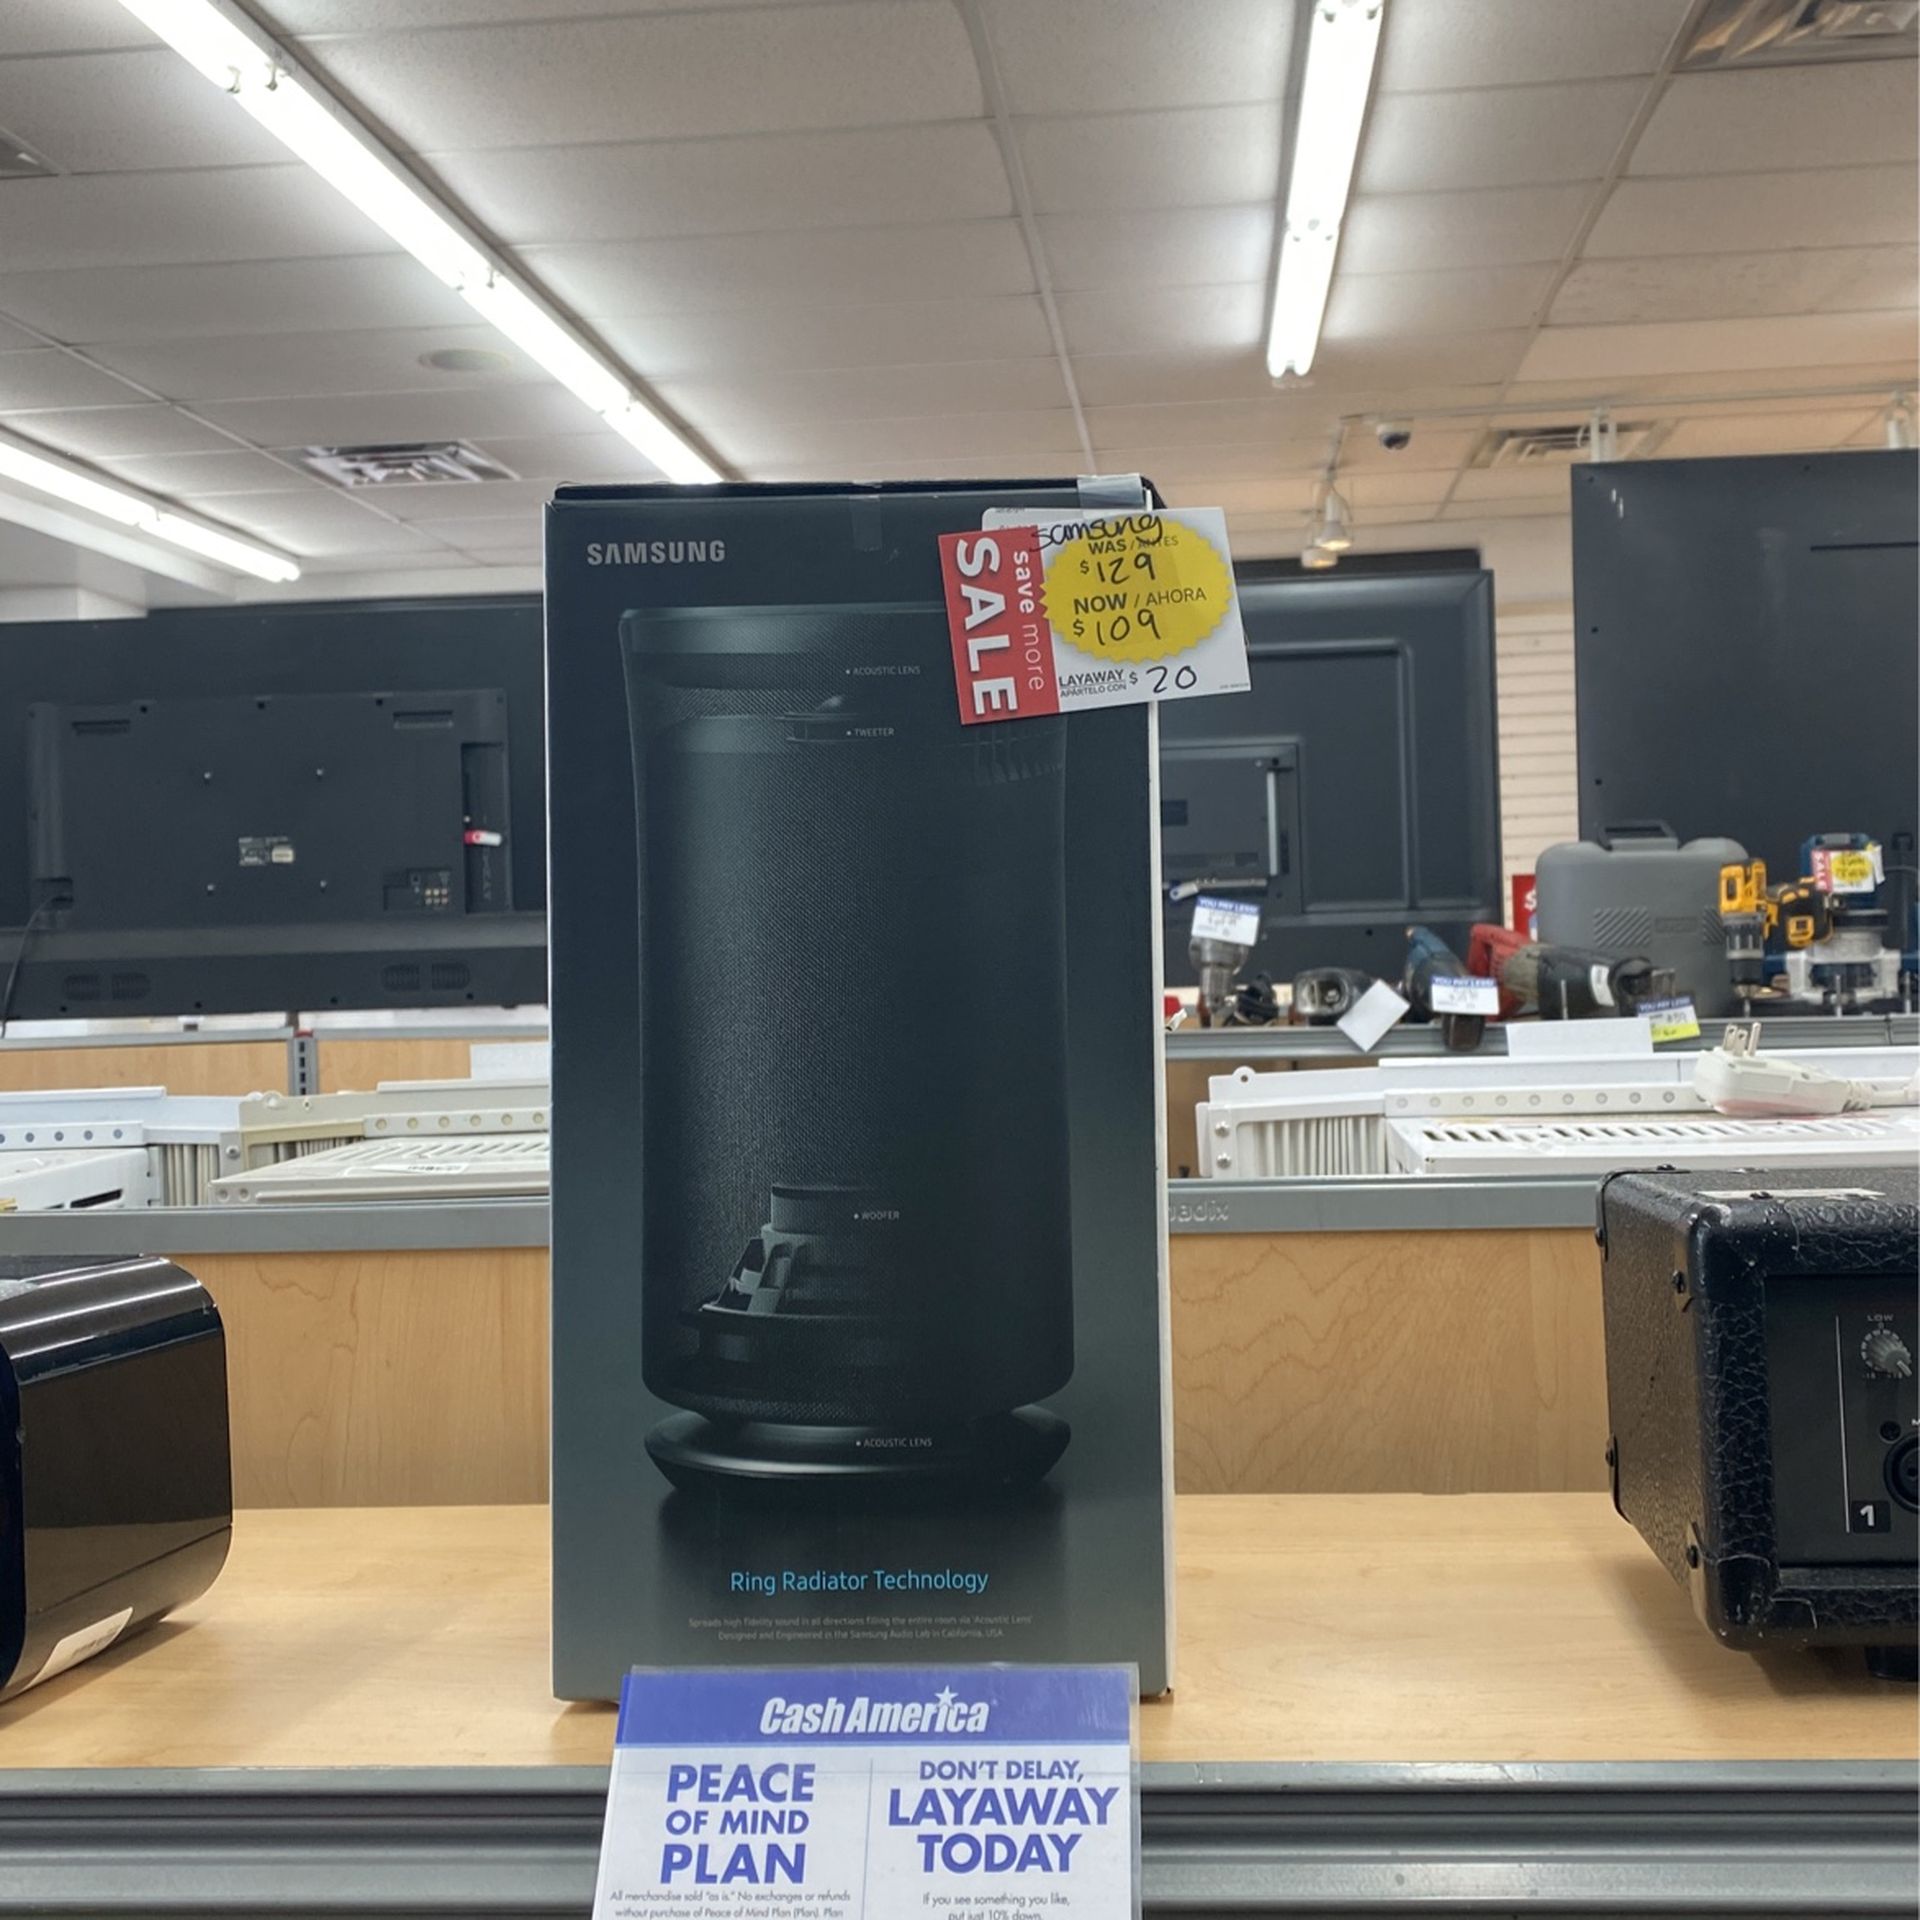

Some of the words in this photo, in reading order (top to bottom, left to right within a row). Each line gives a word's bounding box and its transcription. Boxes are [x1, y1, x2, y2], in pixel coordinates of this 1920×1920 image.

[587, 540, 726, 565] SAMSUNG
[1088, 539, 1127, 555] WAS
[1013, 550, 1036, 614] save
[1073, 592, 1128, 615] NOW
[1145, 587, 1208, 606] AHORA
[956, 537, 1019, 716] SALE
[1022, 623, 1045, 691] more
[853, 666, 896, 676] ACOUSTIC
[898, 665, 921, 675] LENS
[1058, 669, 1125, 688] LAYAWAY
[1107, 683, 1127, 692] CON
[854, 727, 895, 737] TWEETER
[861, 1211, 900, 1220] WOOFER
[1867, 1313, 1894, 1321] LOW
[864, 1438, 907, 1448] ACOUSTIC
[909, 1438, 933, 1447] LENS
[1860, 1505, 1875, 1525] 1
[730, 1571, 776, 1596] Ring
[782, 1570, 868, 1592] Radiator
[873, 1568, 990, 1594] Technology
[919, 1761, 998, 1780] DON'T
[1005, 1761, 1084, 1782] DELAY,
[667, 1763, 815, 1803] PEACE
[888, 1787, 1119, 1826] LAYAWAY
[665, 1810, 709, 1835] OF
[719, 1810, 809, 1835] MIND
[660, 1843, 806, 1884] PLAN
[917, 1833, 1082, 1874] TODAY
[610, 1890, 623, 1901] All
[624, 1890, 682, 1901] merchandise
[684, 1890, 703, 1901] sold
[737, 1890, 753, 1901] No
[754, 1890, 803, 1905] exchanges
[804, 1893, 815, 1901] or
[817, 1890, 851, 1901] refunds
[922, 1892, 931, 1905] If
[932, 1897, 951, 1908] you
[954, 1897, 972, 1905] see
[974, 1893, 1026, 1907] something
[1028, 1897, 1048, 1908] you
[615, 1907, 648, 1918] without
[649, 1907, 691, 1920] purchase
[693, 1906, 704, 1918] of
[705, 1907, 732, 1918] Peace
[733, 1906, 744, 1918] of
[745, 1906, 770, 1918] Mind
[771, 1907, 791, 1918] Plan
[823, 1907, 843, 1918] Plan
[988, 1910, 1009, 1920] 10%
